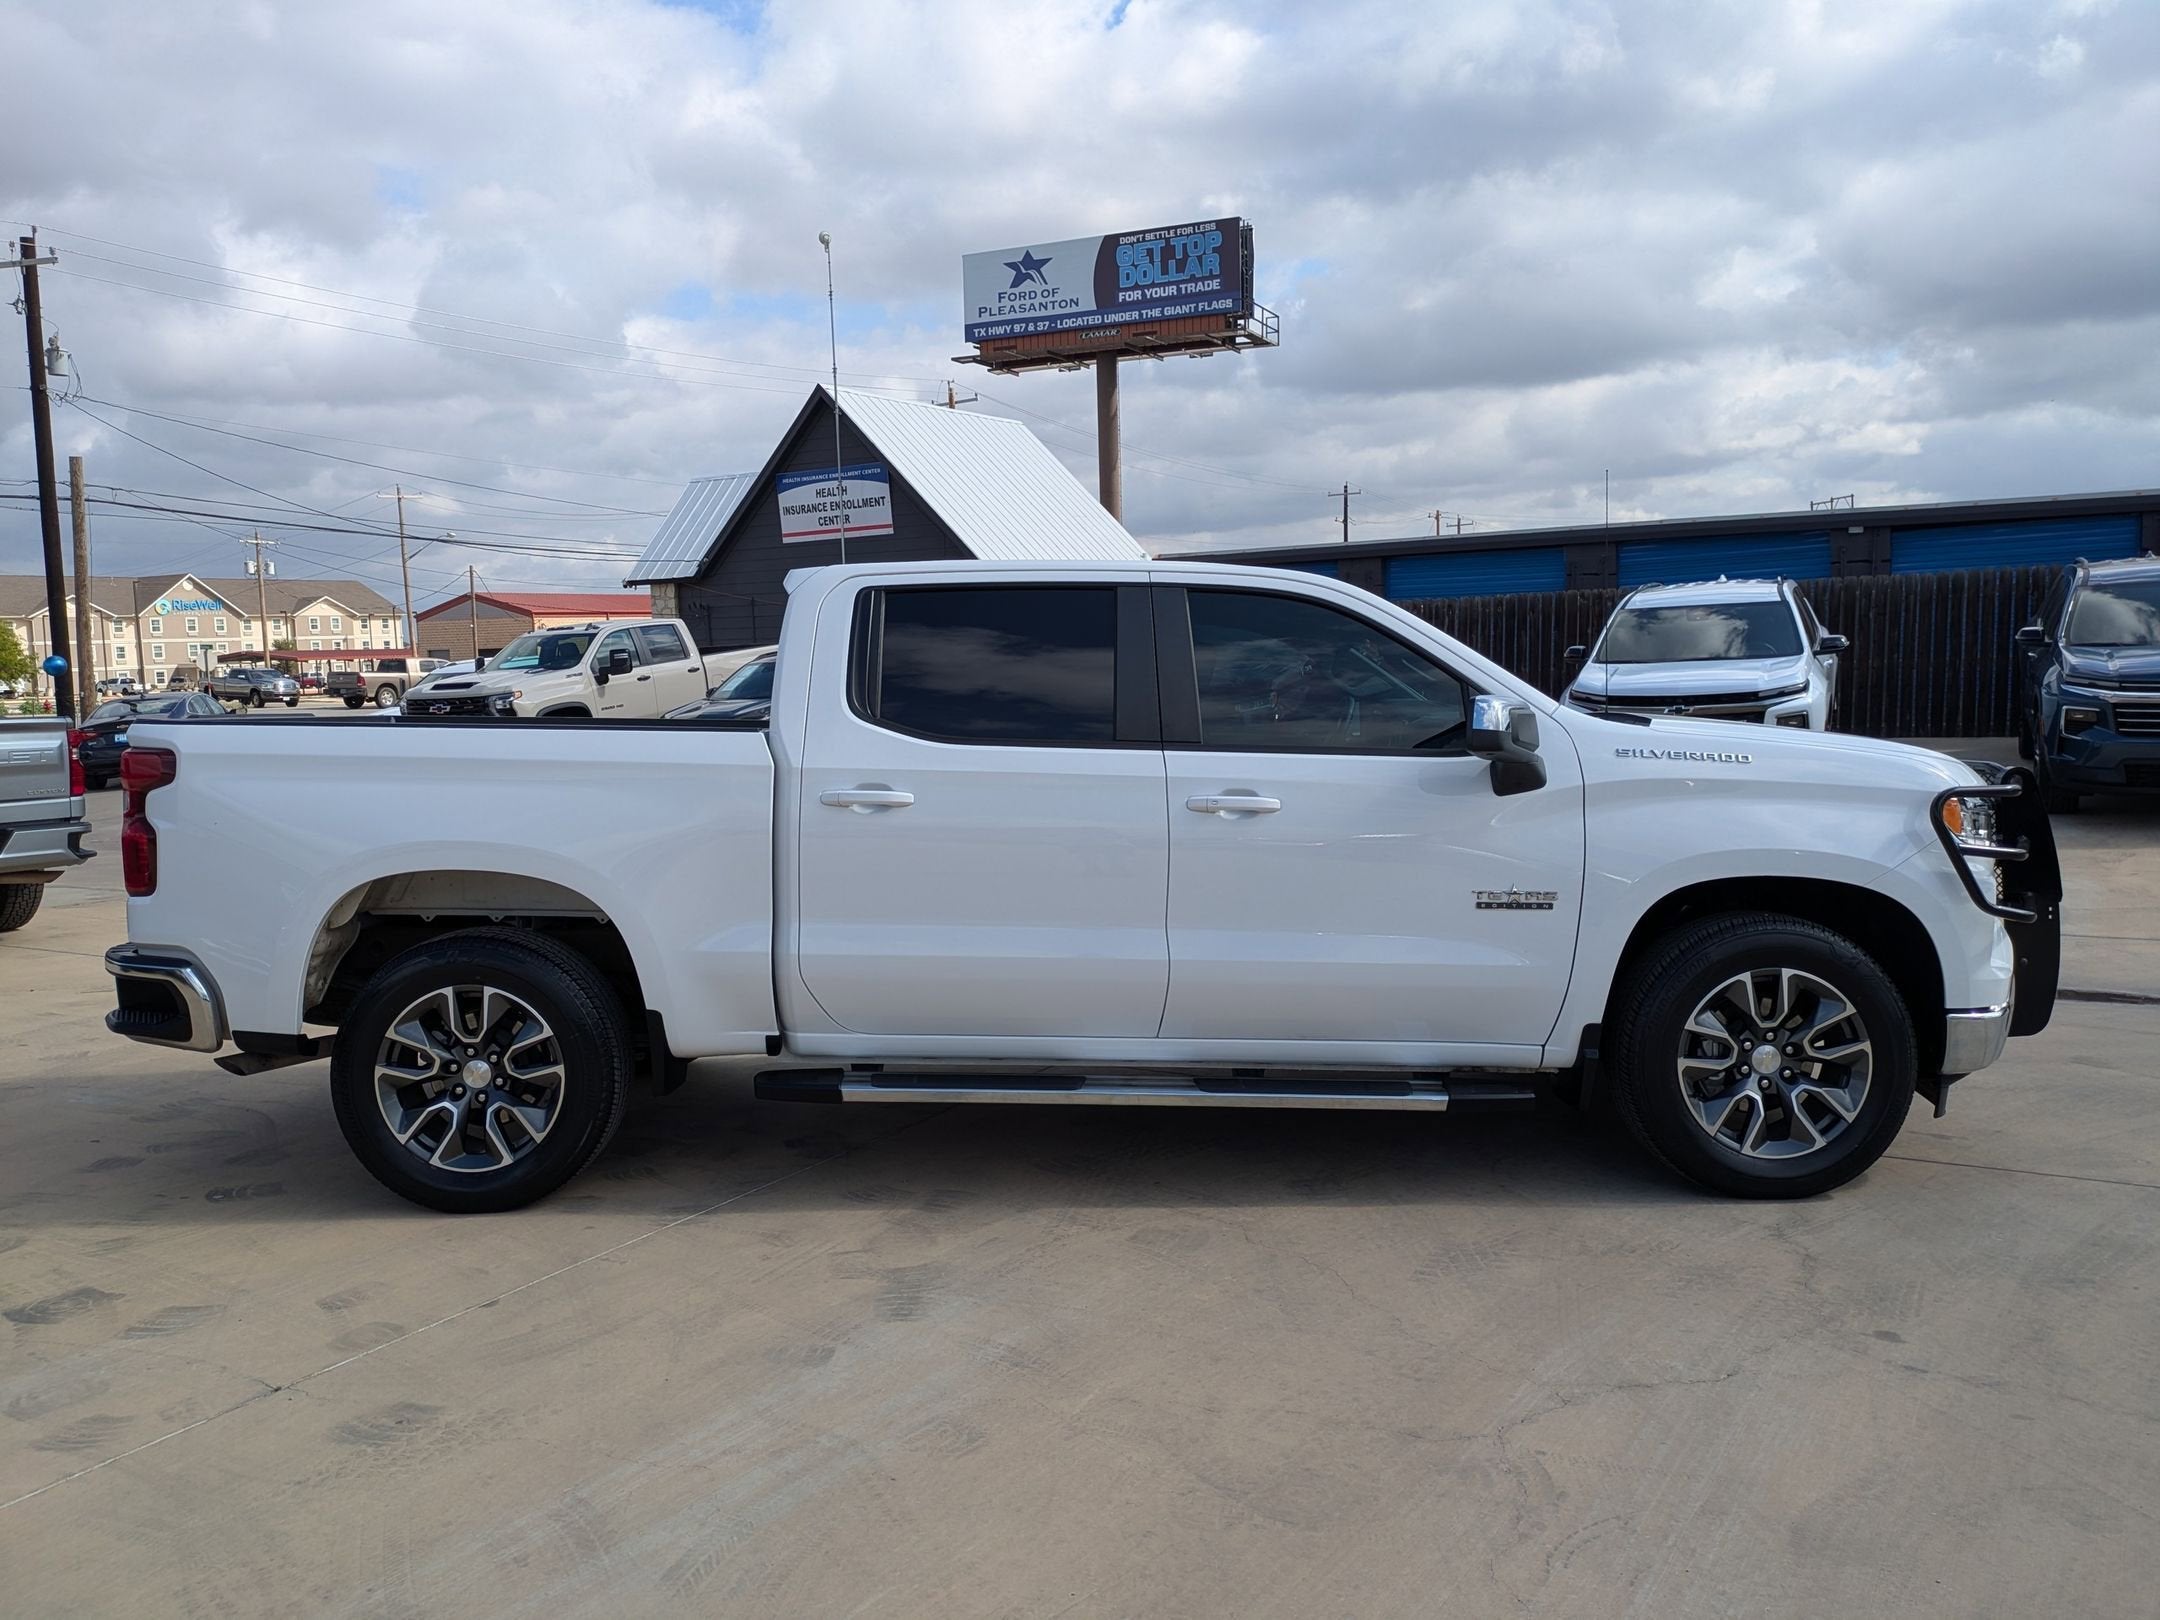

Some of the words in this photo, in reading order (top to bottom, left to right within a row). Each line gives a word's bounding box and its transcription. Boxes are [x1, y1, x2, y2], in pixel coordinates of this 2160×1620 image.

[1120, 234, 1144, 244] DON'T
[1145, 230, 1176, 241] SETTLE
[1177, 226, 1194, 236] FOR
[1195, 222, 1216, 233] LESS
[1116, 240, 1166, 266] GET
[1170, 230, 1222, 259] TOP
[1119, 253, 1220, 288] DOLLAR
[998, 290, 1038, 303] FORD
[1041, 288, 1060, 298] OF
[1119, 289, 1142, 302] FOR
[1144, 285, 1177, 299] YOUR
[1180, 279, 1220, 294] TRADE
[978, 297, 1080, 318] PLEASANTON
[974, 328, 986, 338] TX
[988, 324, 1012, 336] HWY
[1014, 323, 1026, 333] 97
[1028, 322, 1036, 332] &
[1037, 321, 1050, 330] 37
[1057, 315, 1102, 328] LOCATED
[1104, 312, 1139, 323] UNDER
[1141, 308, 1162, 318] THE
[1164, 304, 1196, 316] GIANT
[1198, 298, 1232, 312] FLAGS
[1082, 329, 1118, 339] LAMAR
[802, 474, 828, 482] INSURANCE
[816, 486, 848, 498] HEALTH
[782, 502, 828, 516] INSURANCE
[830, 496, 886, 512] ENROLLMENT
[172, 600, 222, 611] RiseWell
[1616, 748, 1753, 764] SILVERADO
